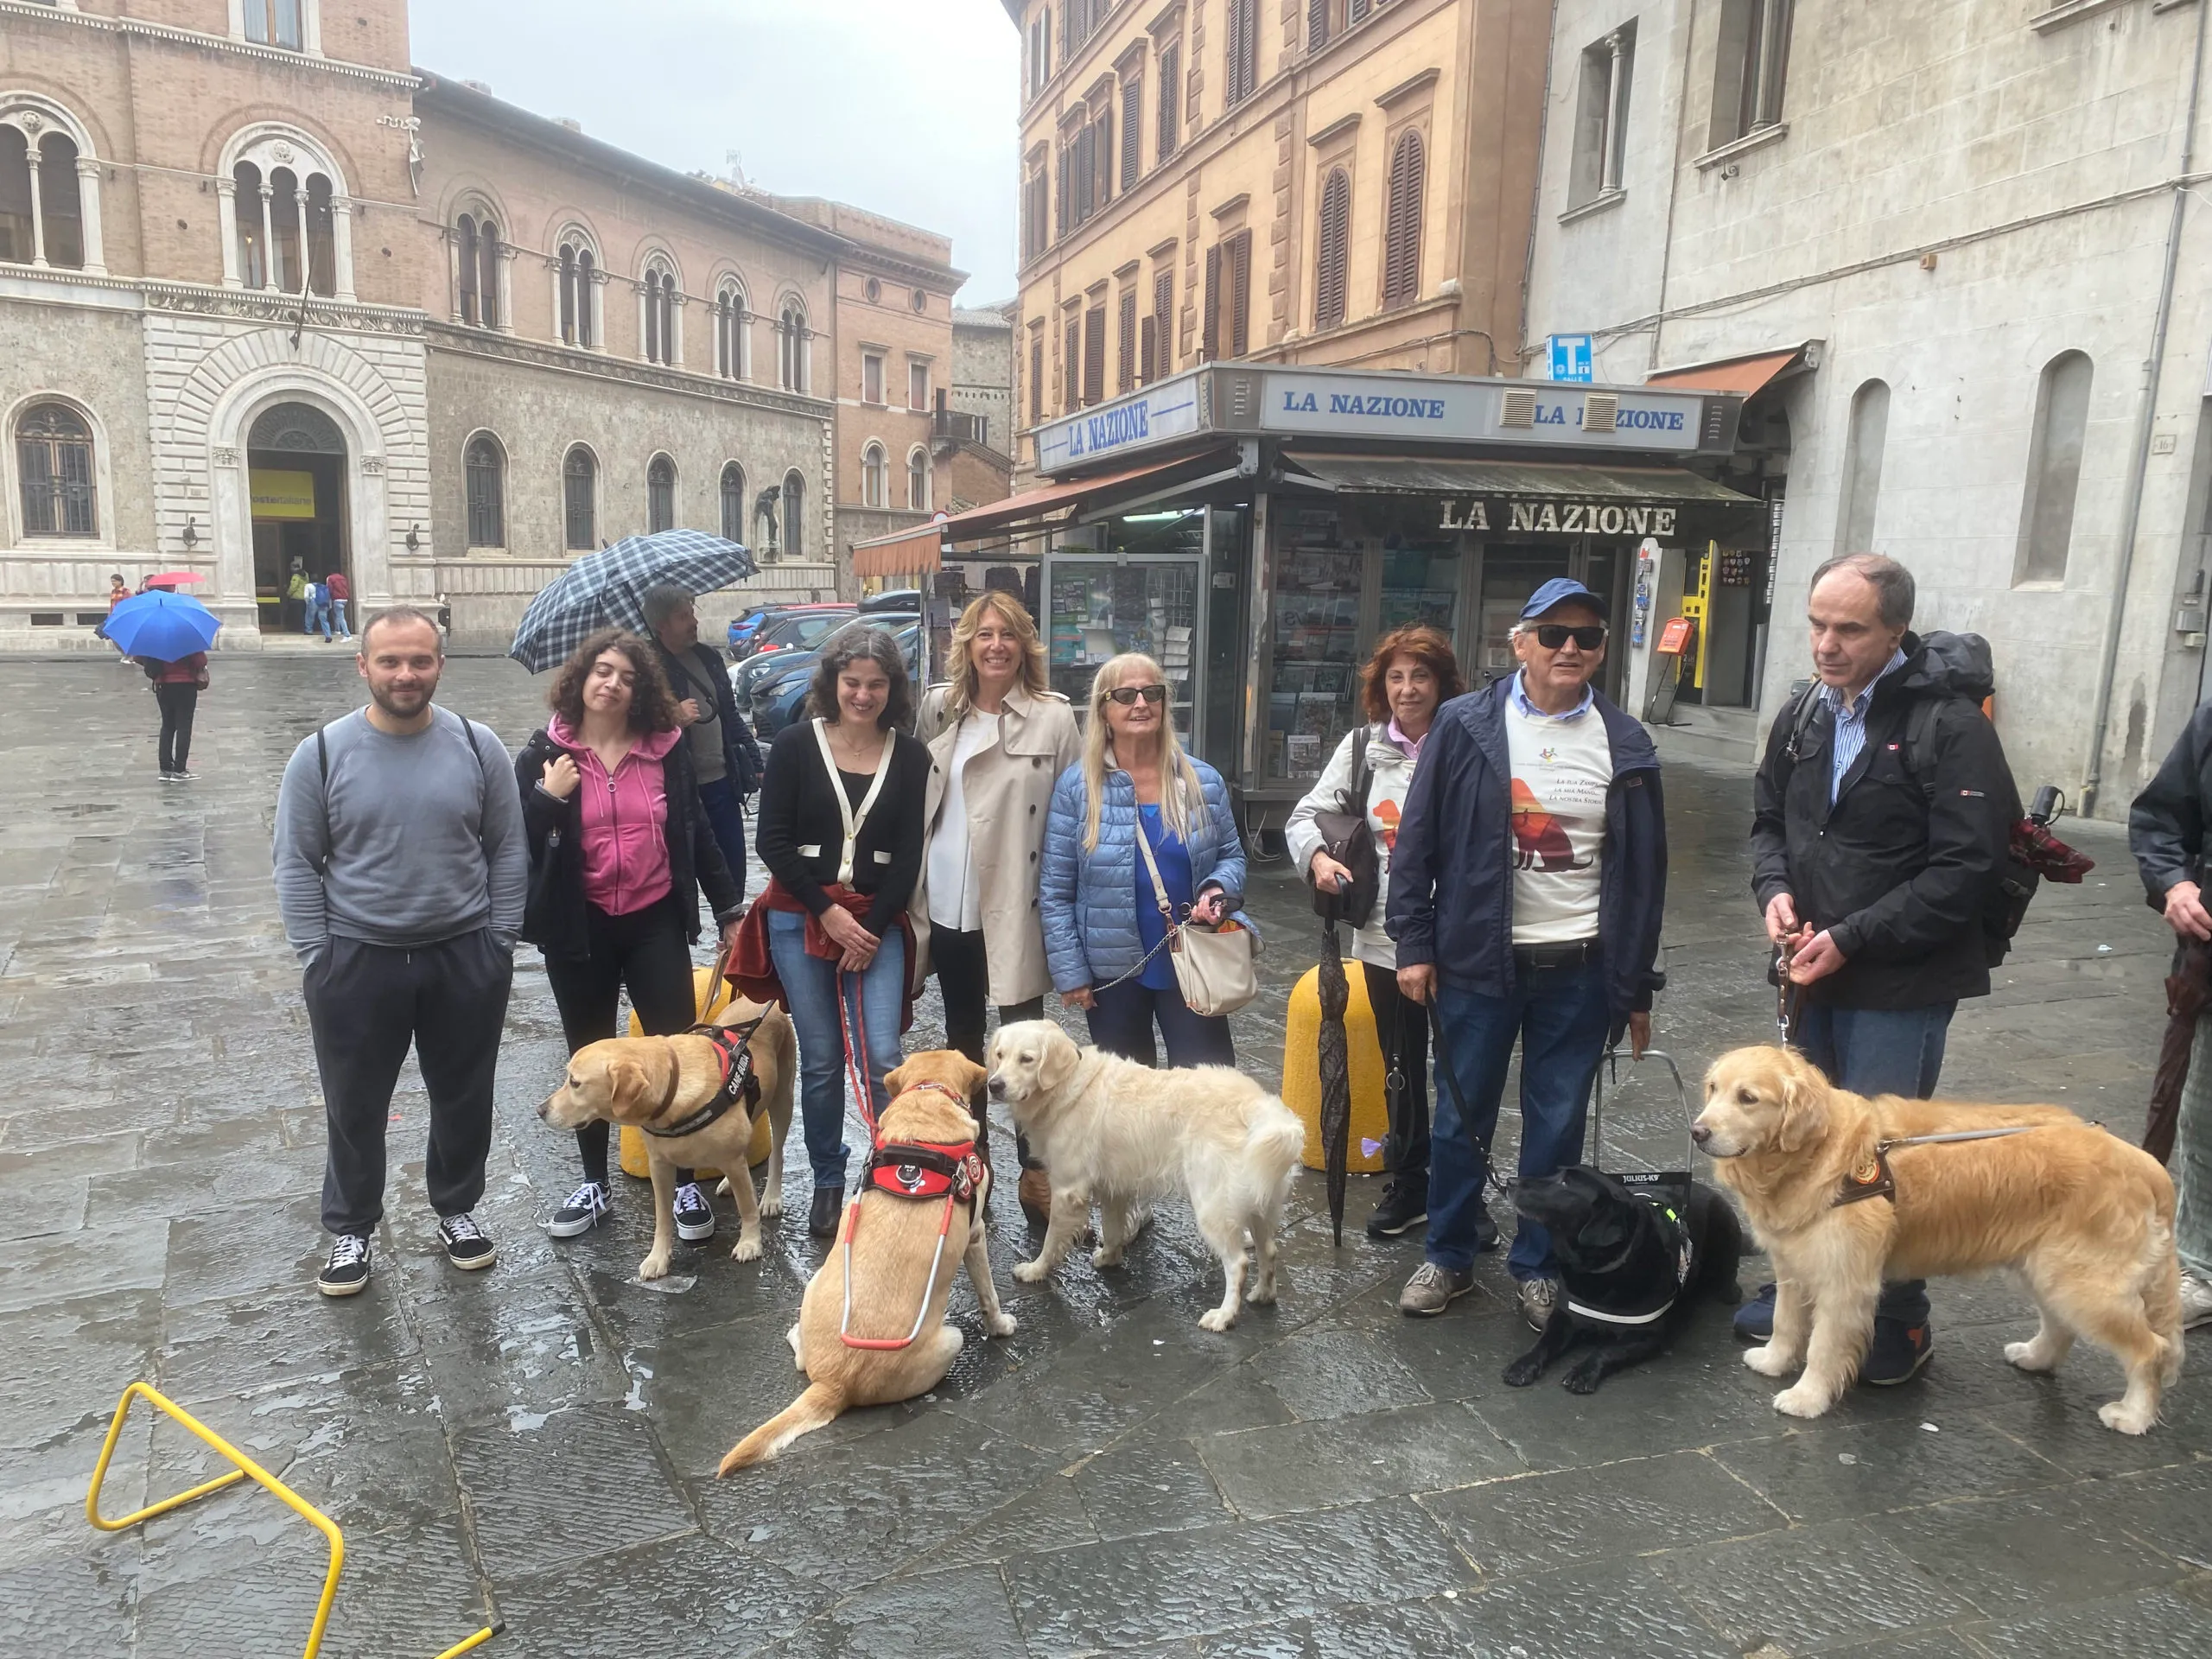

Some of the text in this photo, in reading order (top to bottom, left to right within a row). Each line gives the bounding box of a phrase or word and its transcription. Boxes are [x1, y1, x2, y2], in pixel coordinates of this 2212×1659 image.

[1283, 391, 1445, 419] LA NAZIONE
[1534, 405, 1684, 430] LA ZIONE
[1069, 399, 1149, 457] LA NAZIONE
[252, 495, 312, 505] osteitaliane
[1440, 500, 1677, 537] LA NAZIONE
[728, 1053, 749, 1096] CANE GUIDA
